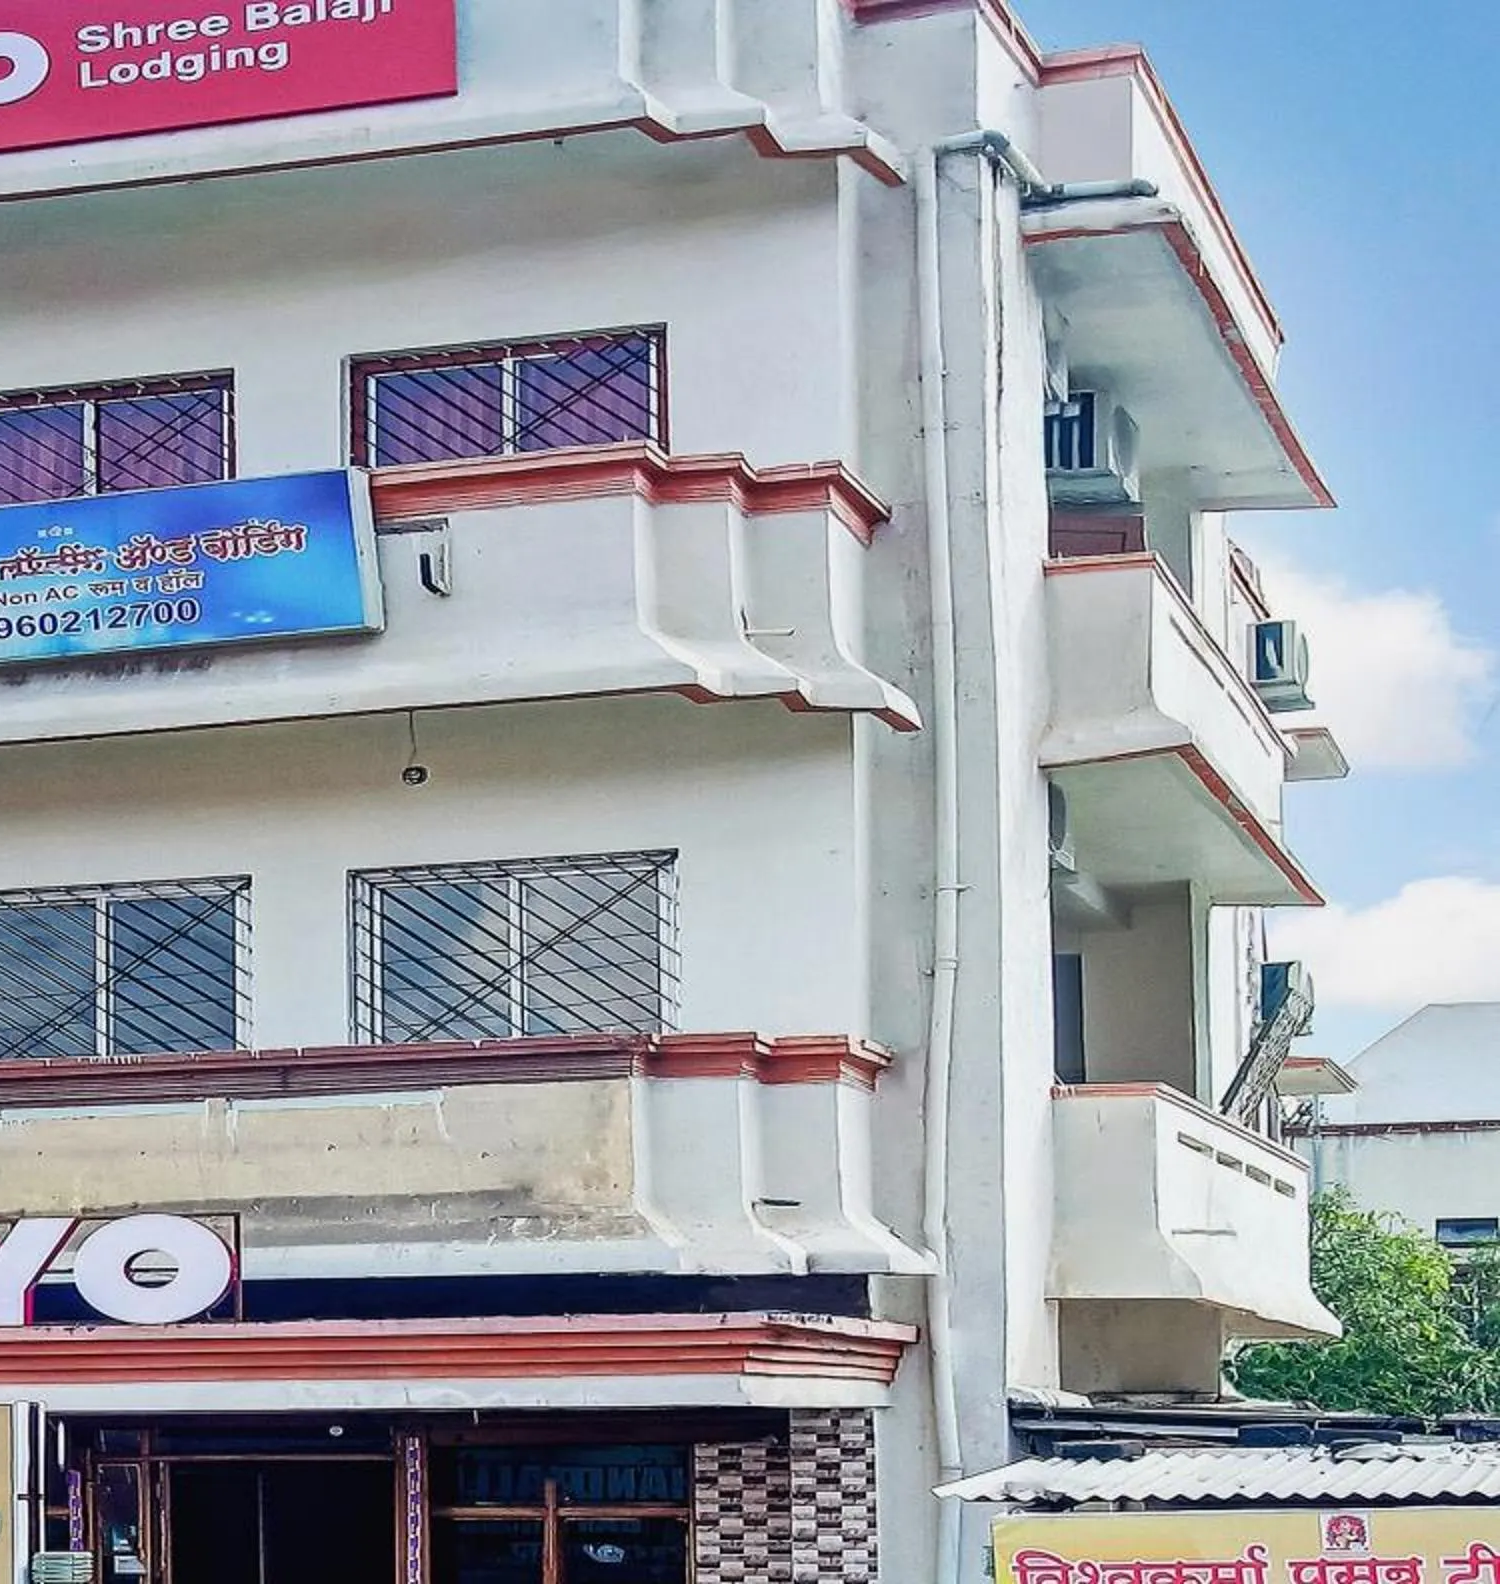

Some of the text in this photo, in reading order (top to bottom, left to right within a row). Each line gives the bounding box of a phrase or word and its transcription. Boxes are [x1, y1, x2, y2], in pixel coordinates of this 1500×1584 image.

[77, 13, 230, 54] Shree
[79, 40, 290, 88] Lodging
[46, 585, 79, 601] AC
